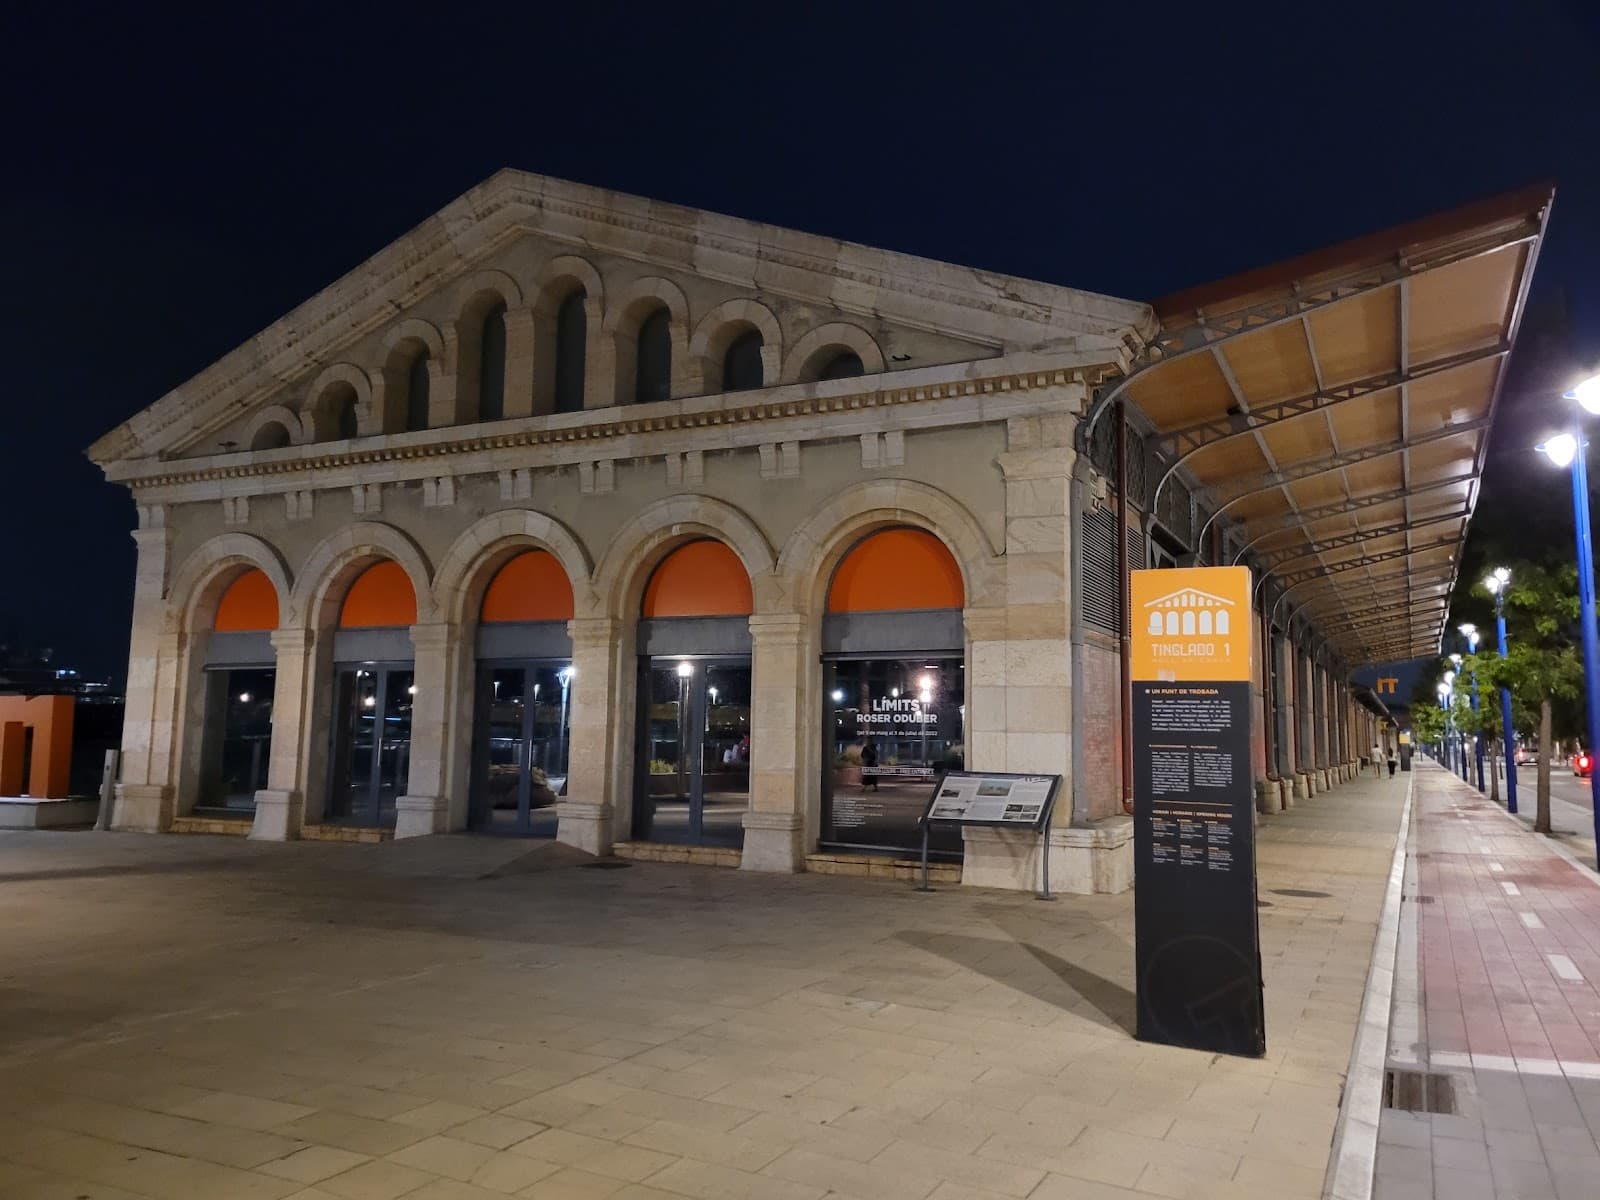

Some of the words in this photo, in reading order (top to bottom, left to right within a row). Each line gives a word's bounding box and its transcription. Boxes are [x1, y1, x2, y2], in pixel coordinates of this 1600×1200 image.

[1151, 643, 1215, 657] TINGLADO
[1223, 642, 1231, 657] 1
[872, 696, 921, 712] LÍMITS
[856, 713, 891, 723] ROSER
[893, 713, 938, 723] ODUBER
